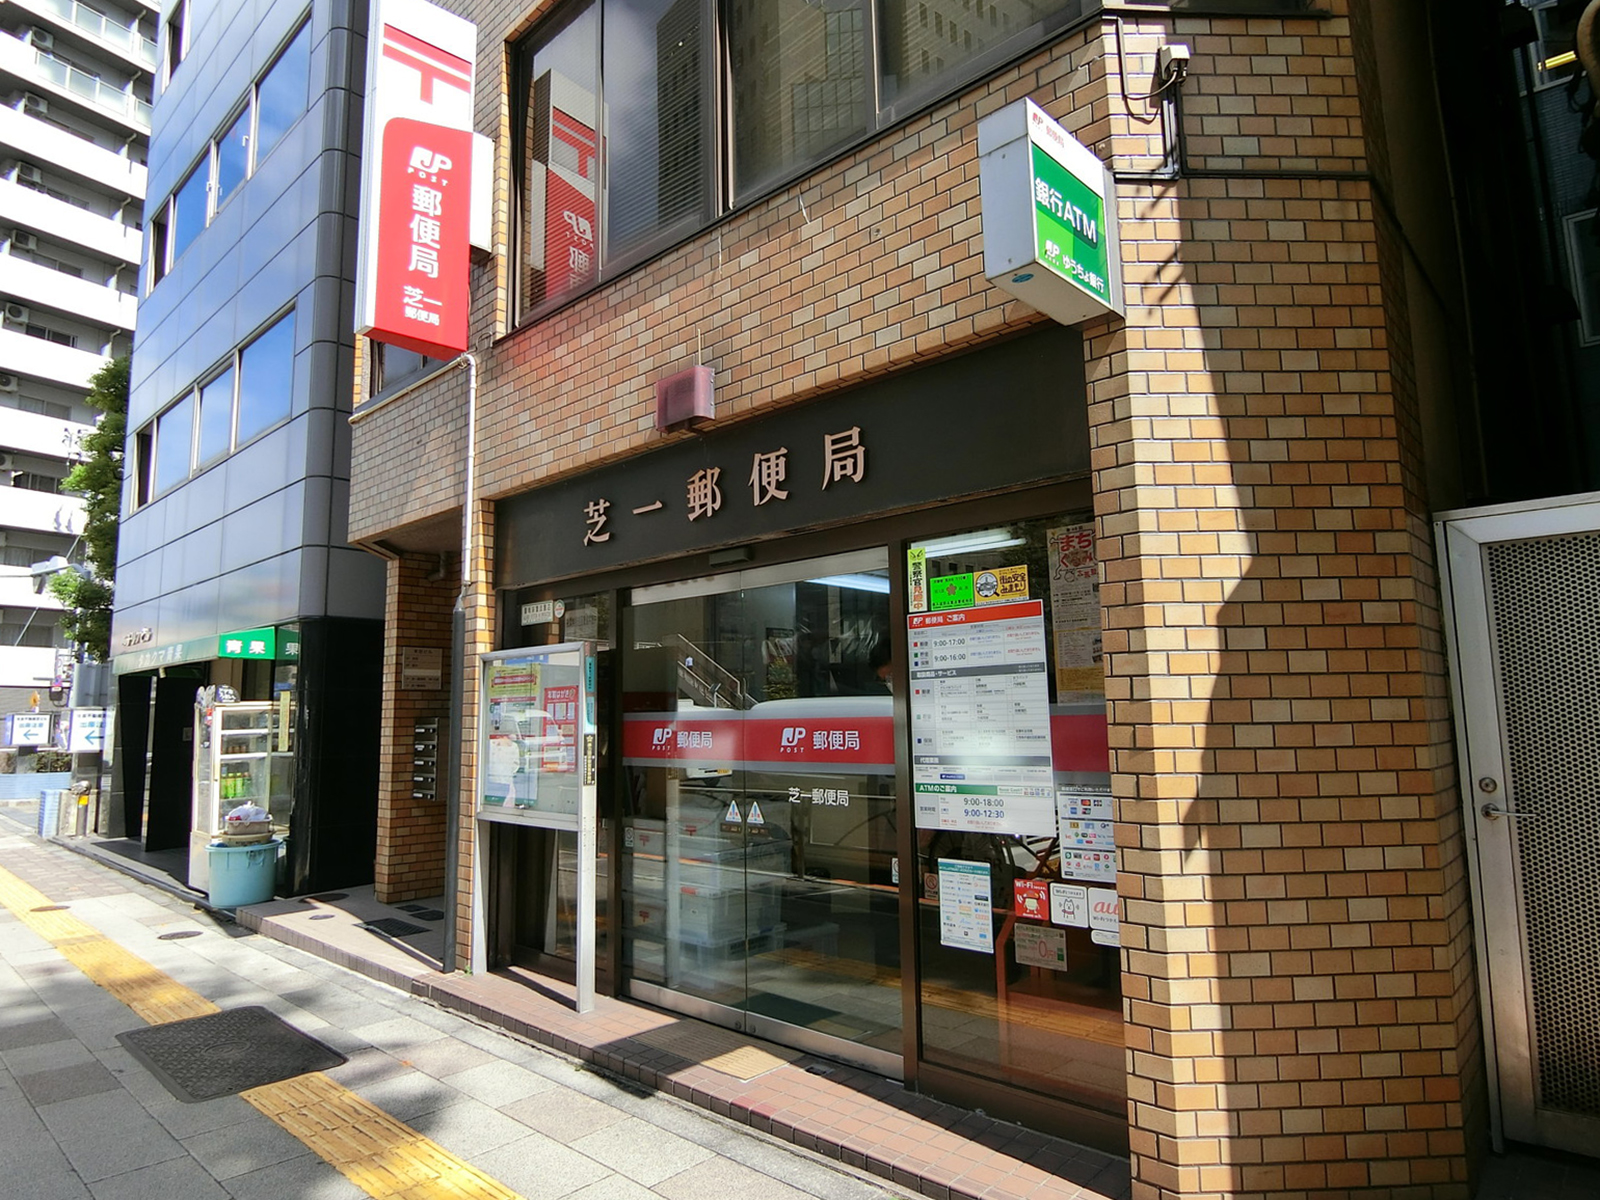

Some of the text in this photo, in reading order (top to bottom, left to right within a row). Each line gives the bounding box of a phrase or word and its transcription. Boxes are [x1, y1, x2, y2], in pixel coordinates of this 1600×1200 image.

[407, 166, 449, 187] POST
[1035, 177, 1097, 244] 銀行ATM
[408, 184, 443, 279] 郵便局
[1062, 254, 1105, 294] ゆうちょ銀行
[403, 285, 443, 308] 芝一
[404, 305, 440, 326] 郵便局
[583, 426, 867, 547] 芝一郵便局
[1059, 532, 1093, 552] まち
[225, 639, 266, 655] 青果
[933, 638, 966, 647] 9:00-17:00
[934, 653, 966, 663] 9:00-16:00
[677, 731, 713, 749] 郵便局
[813, 730, 860, 750] 郵便局
[788, 787, 849, 807] 芝一郵便局
[918, 784, 957, 794] ATMのご案内
[963, 797, 1005, 808] 9:00-18:00
[963, 808, 1005, 819] 9:00-12:30
